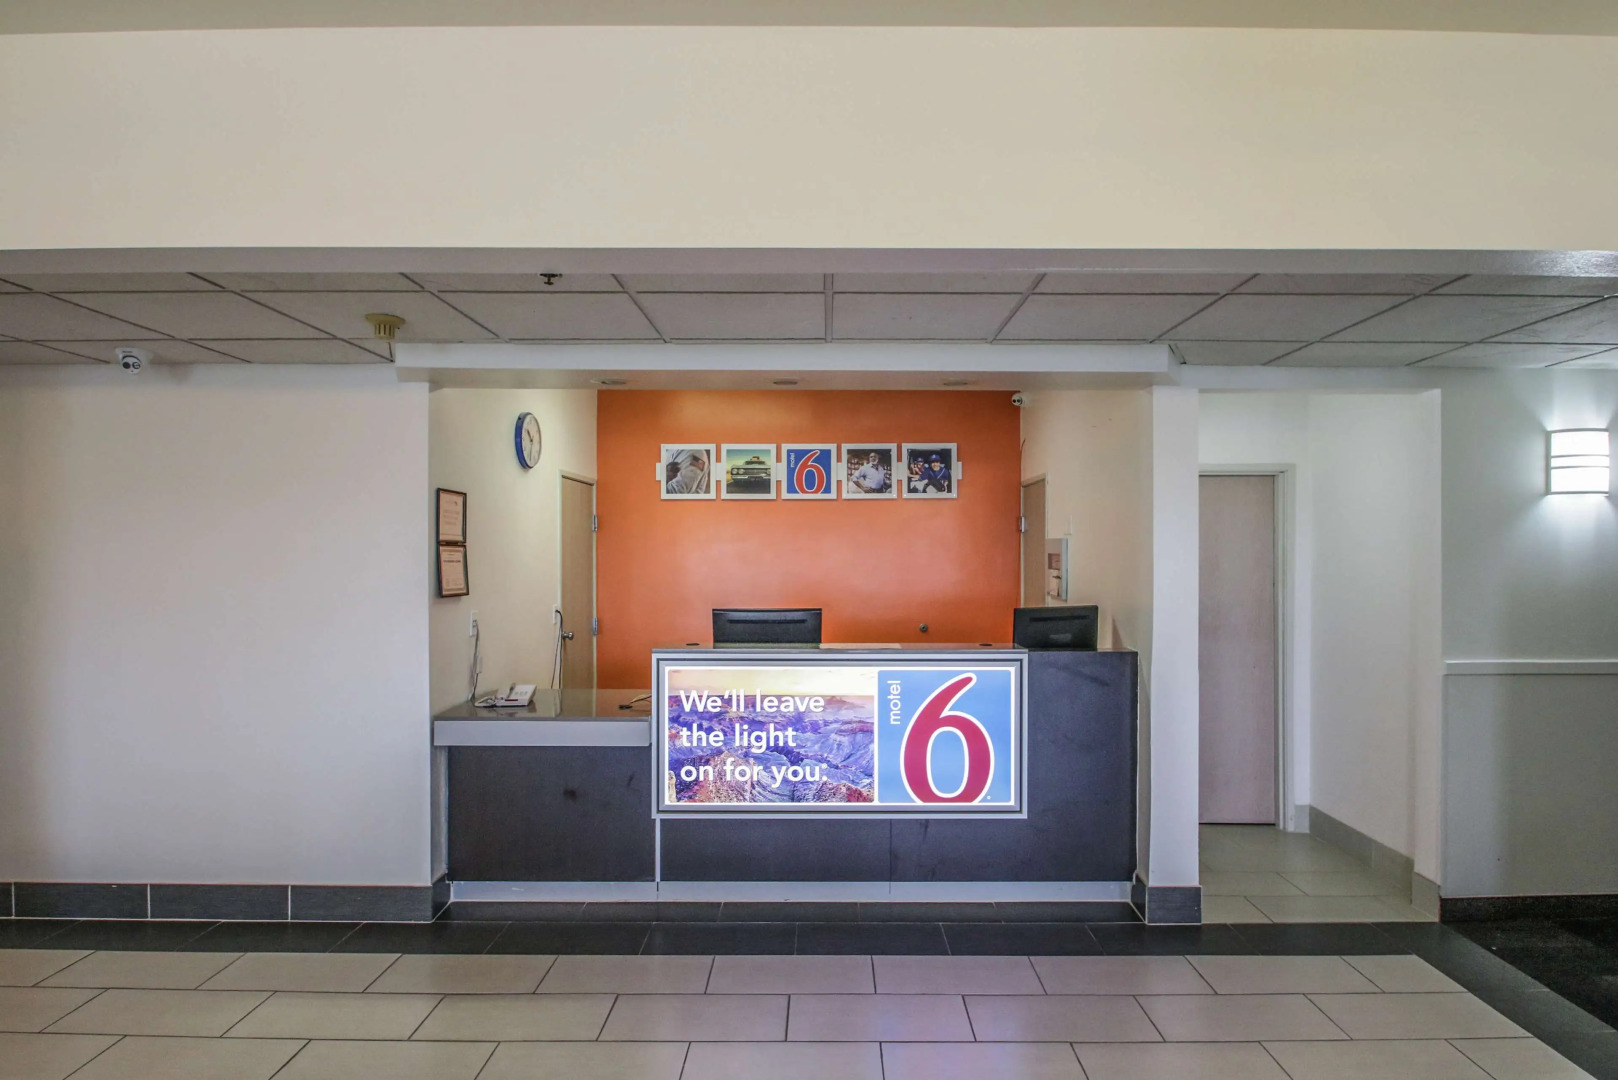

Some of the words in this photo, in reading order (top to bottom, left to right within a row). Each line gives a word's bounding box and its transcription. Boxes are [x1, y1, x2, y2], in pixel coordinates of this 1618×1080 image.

[794, 450, 827, 494] 6
[679, 689, 745, 713] We'll
[756, 689, 825, 713] leave
[889, 680, 901, 725] motel
[680, 724, 725, 747] the
[734, 723, 797, 754] light
[900, 672, 995, 803] 6
[680, 763, 714, 782] on
[724, 757, 764, 782] for
